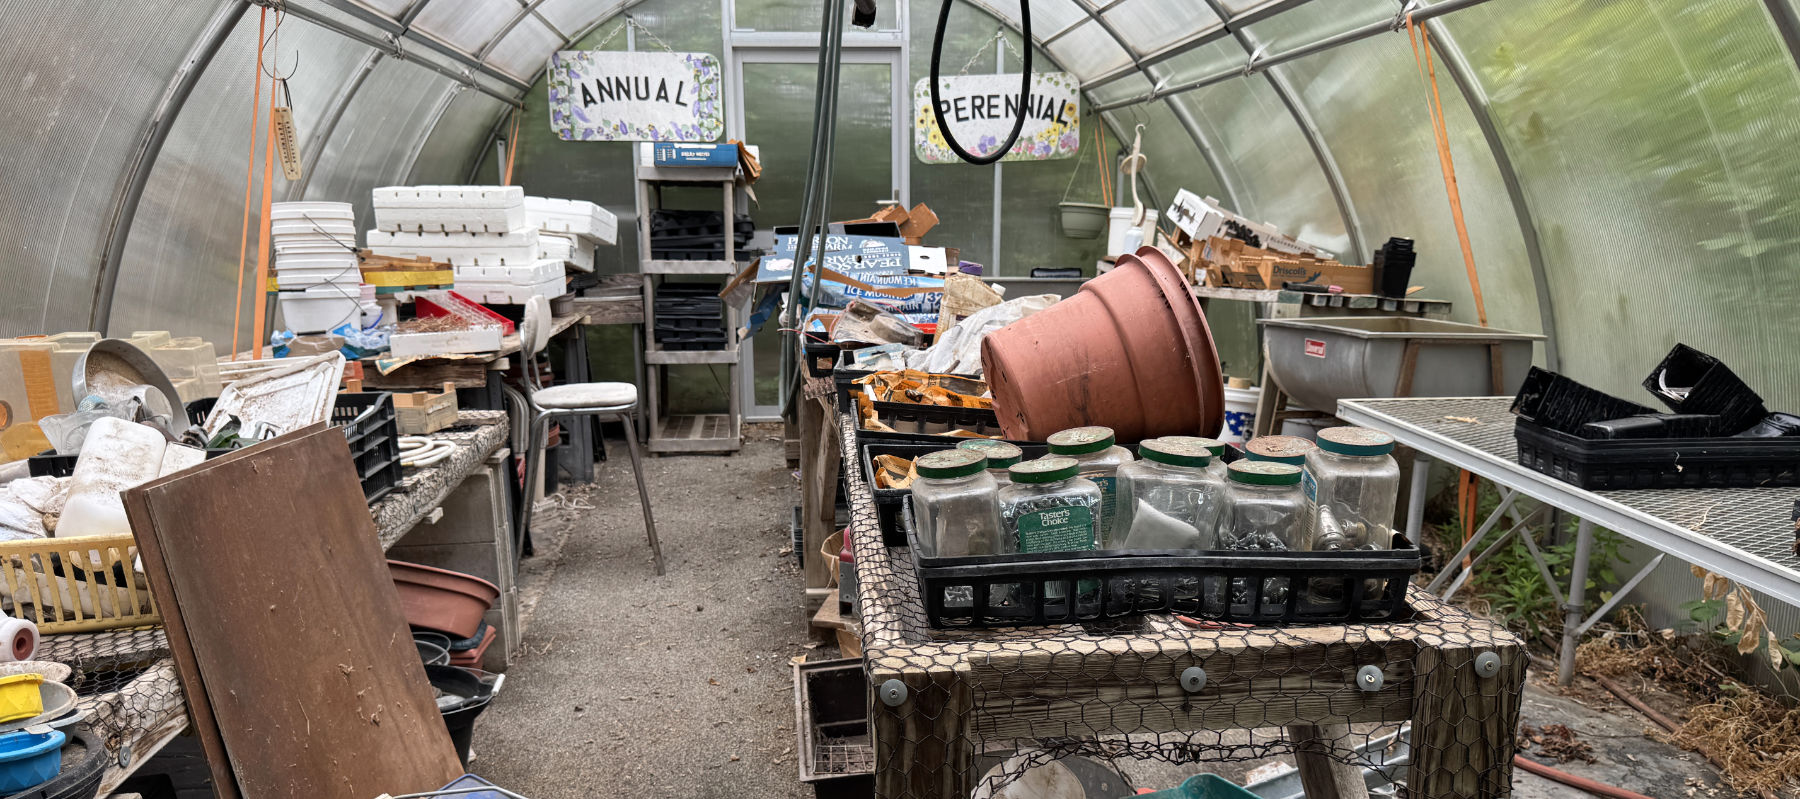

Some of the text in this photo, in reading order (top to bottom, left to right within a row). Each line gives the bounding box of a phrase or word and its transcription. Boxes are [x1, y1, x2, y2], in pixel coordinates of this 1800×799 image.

[581, 76, 687, 108] ANNUAL
[940, 94, 1068, 128] PERENNIAL
[847, 285, 863, 296] ICE
[1039, 508, 1070, 520] Taster's
